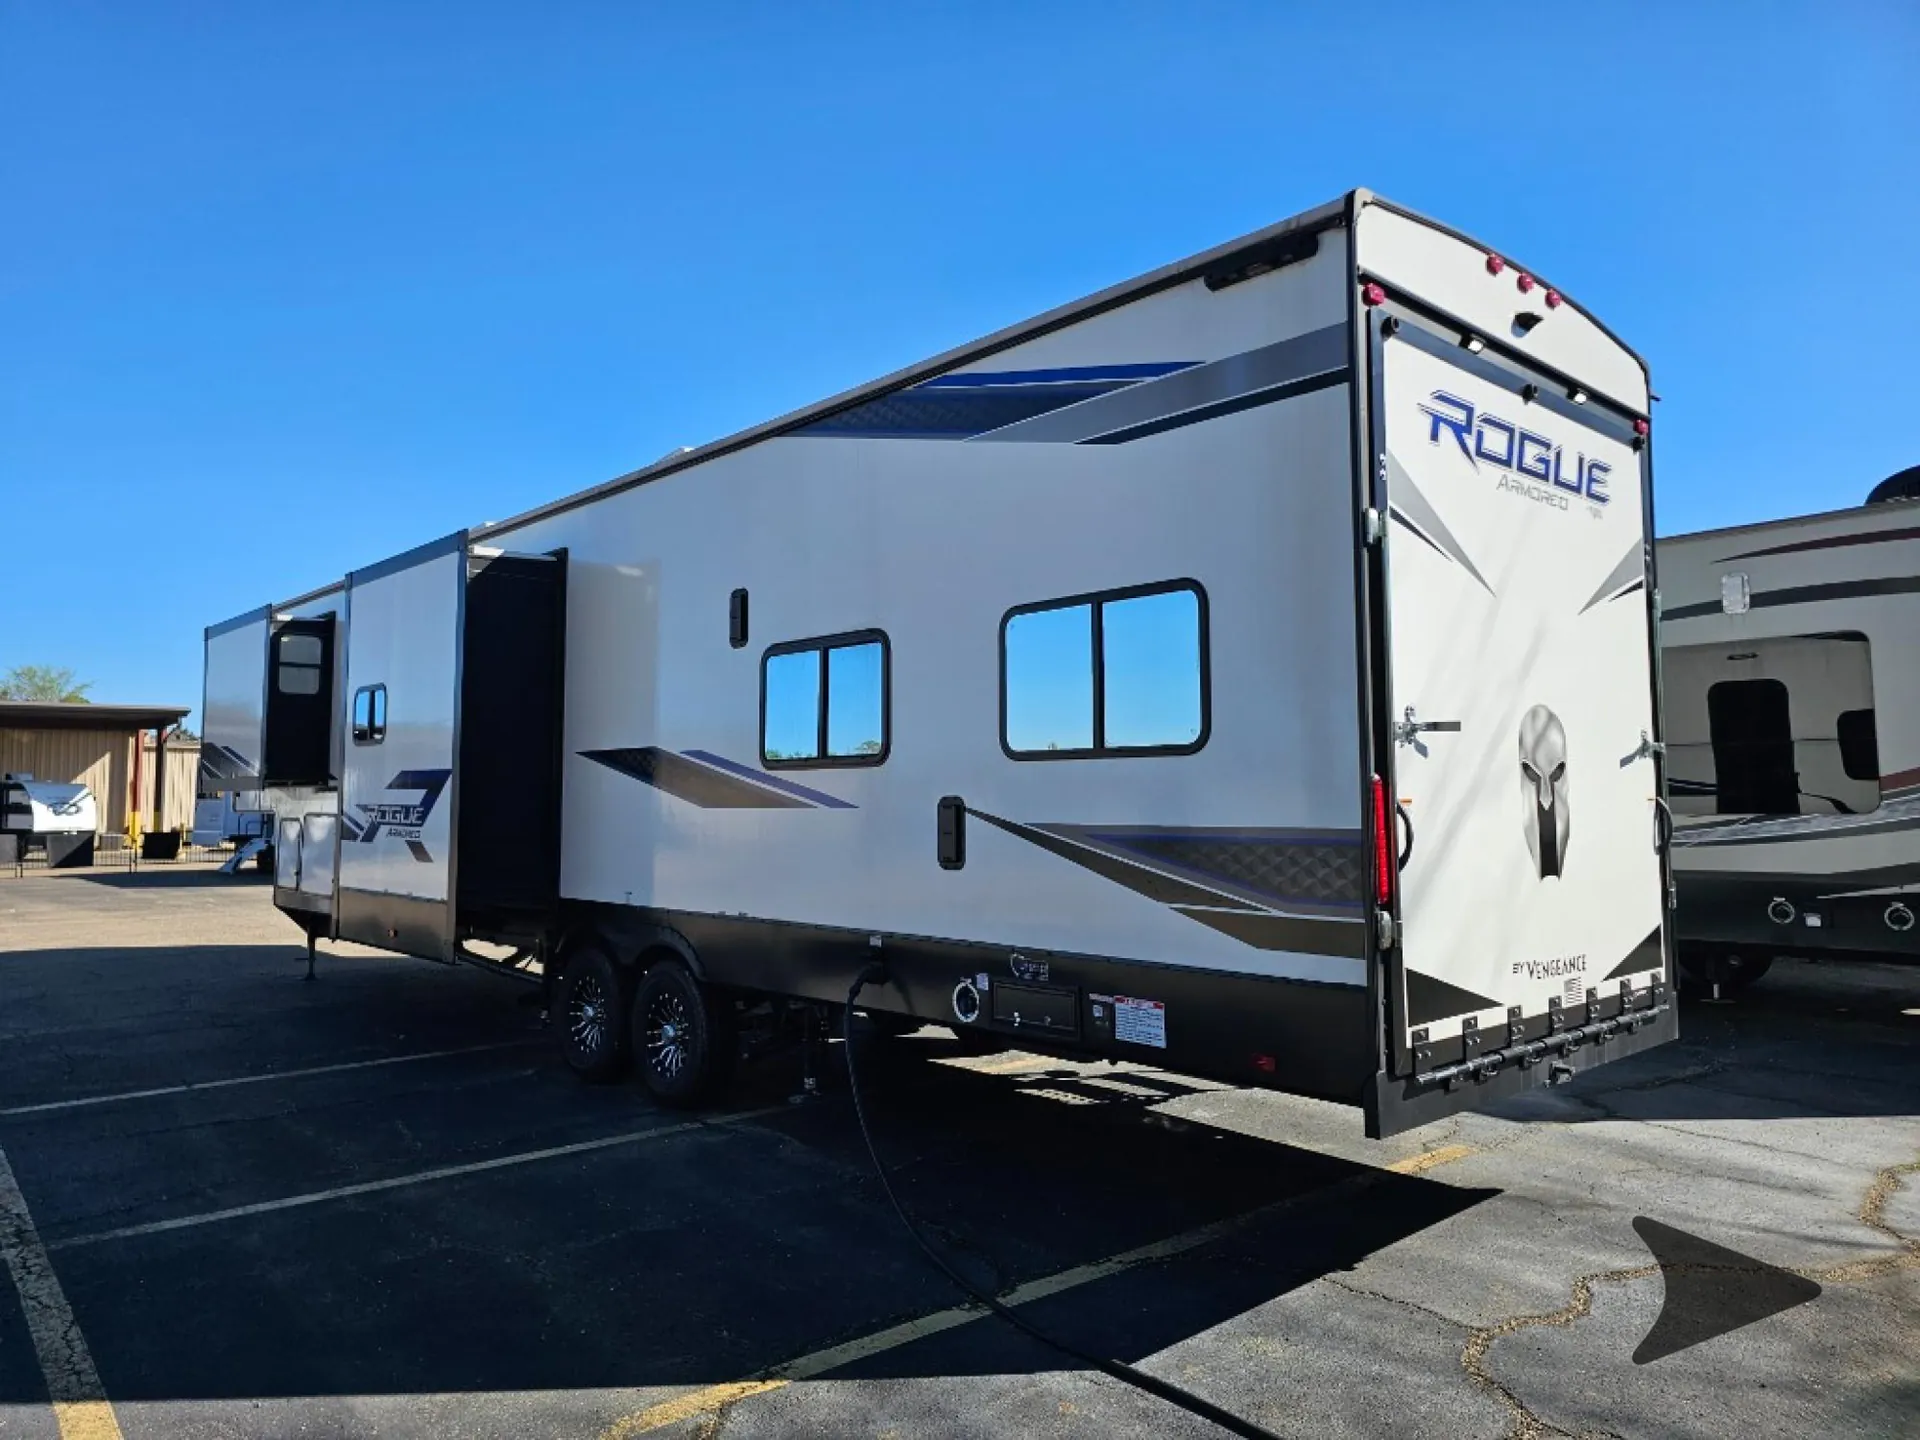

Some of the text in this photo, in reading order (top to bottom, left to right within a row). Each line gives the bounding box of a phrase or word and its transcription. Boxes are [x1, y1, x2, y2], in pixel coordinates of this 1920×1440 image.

[1418, 389, 1612, 504] ROGUE
[1496, 473, 1569, 511] ARMORED
[363, 806, 425, 824] ROGUE
[1512, 953, 1587, 979] BY VENGEANCE
